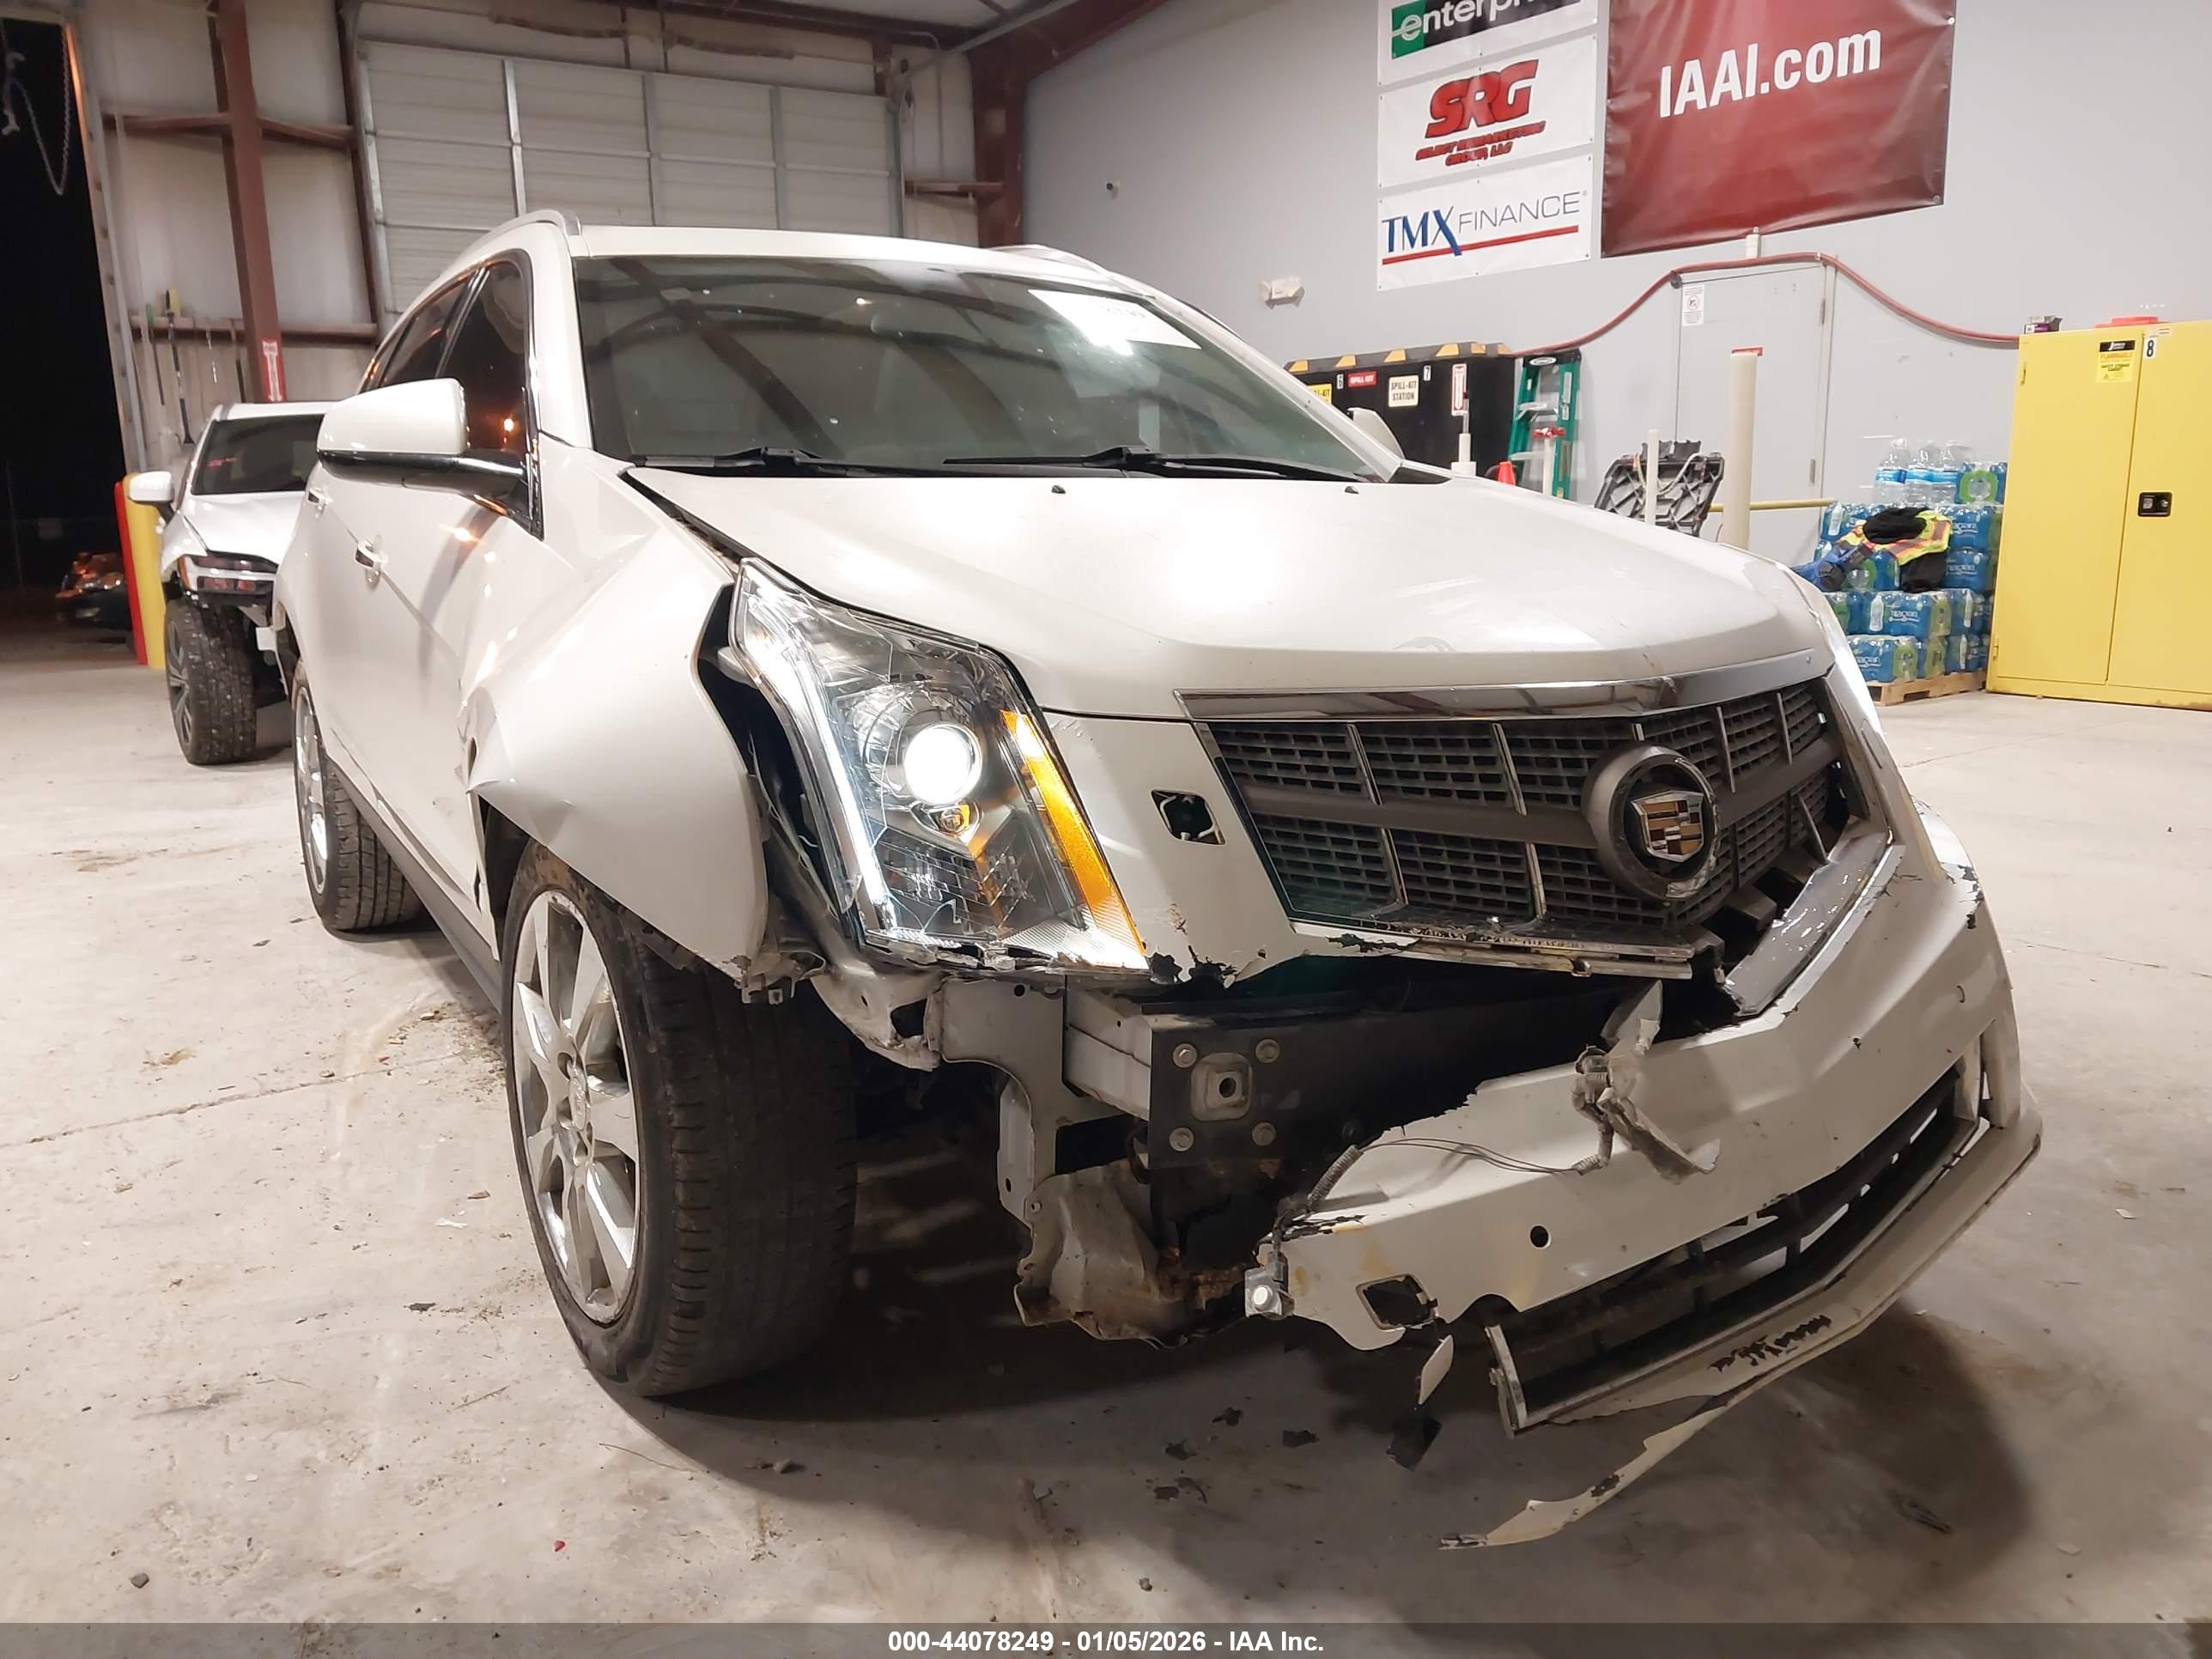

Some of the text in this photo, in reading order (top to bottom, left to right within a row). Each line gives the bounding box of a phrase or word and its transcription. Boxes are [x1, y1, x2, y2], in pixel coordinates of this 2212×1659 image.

[1392, 0, 1532, 40] enterp
[1659, 29, 1881, 118] IAAI.com
[1425, 59, 1539, 138] SRG
[1382, 191, 1580, 256] TMX FINANCE
[2146, 339, 2154, 357] 8
[1391, 380, 1417, 390] SPILL-KIT
[1392, 392, 1415, 401] STATION
